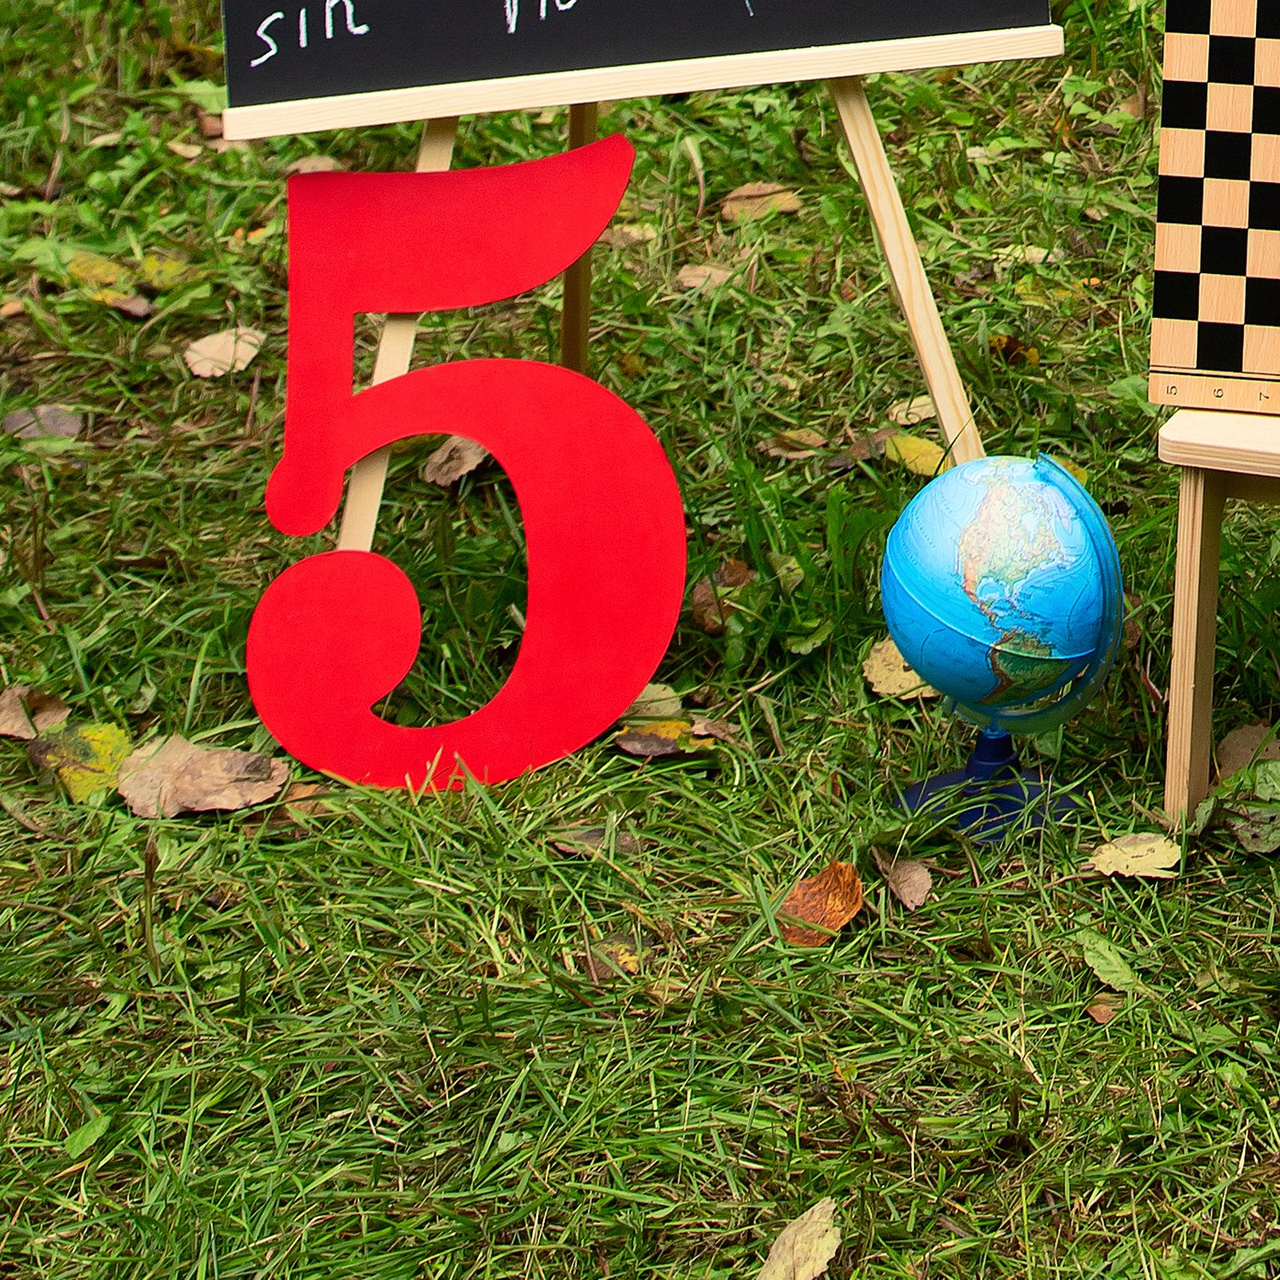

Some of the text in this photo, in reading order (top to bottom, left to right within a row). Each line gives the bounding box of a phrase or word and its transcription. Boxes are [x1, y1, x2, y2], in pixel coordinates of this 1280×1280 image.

[246, 132, 688, 792] 5
[1166, 385, 1178, 396] 5
[1213, 388, 1224, 399] 6
[1258, 392, 1270, 402] 7
